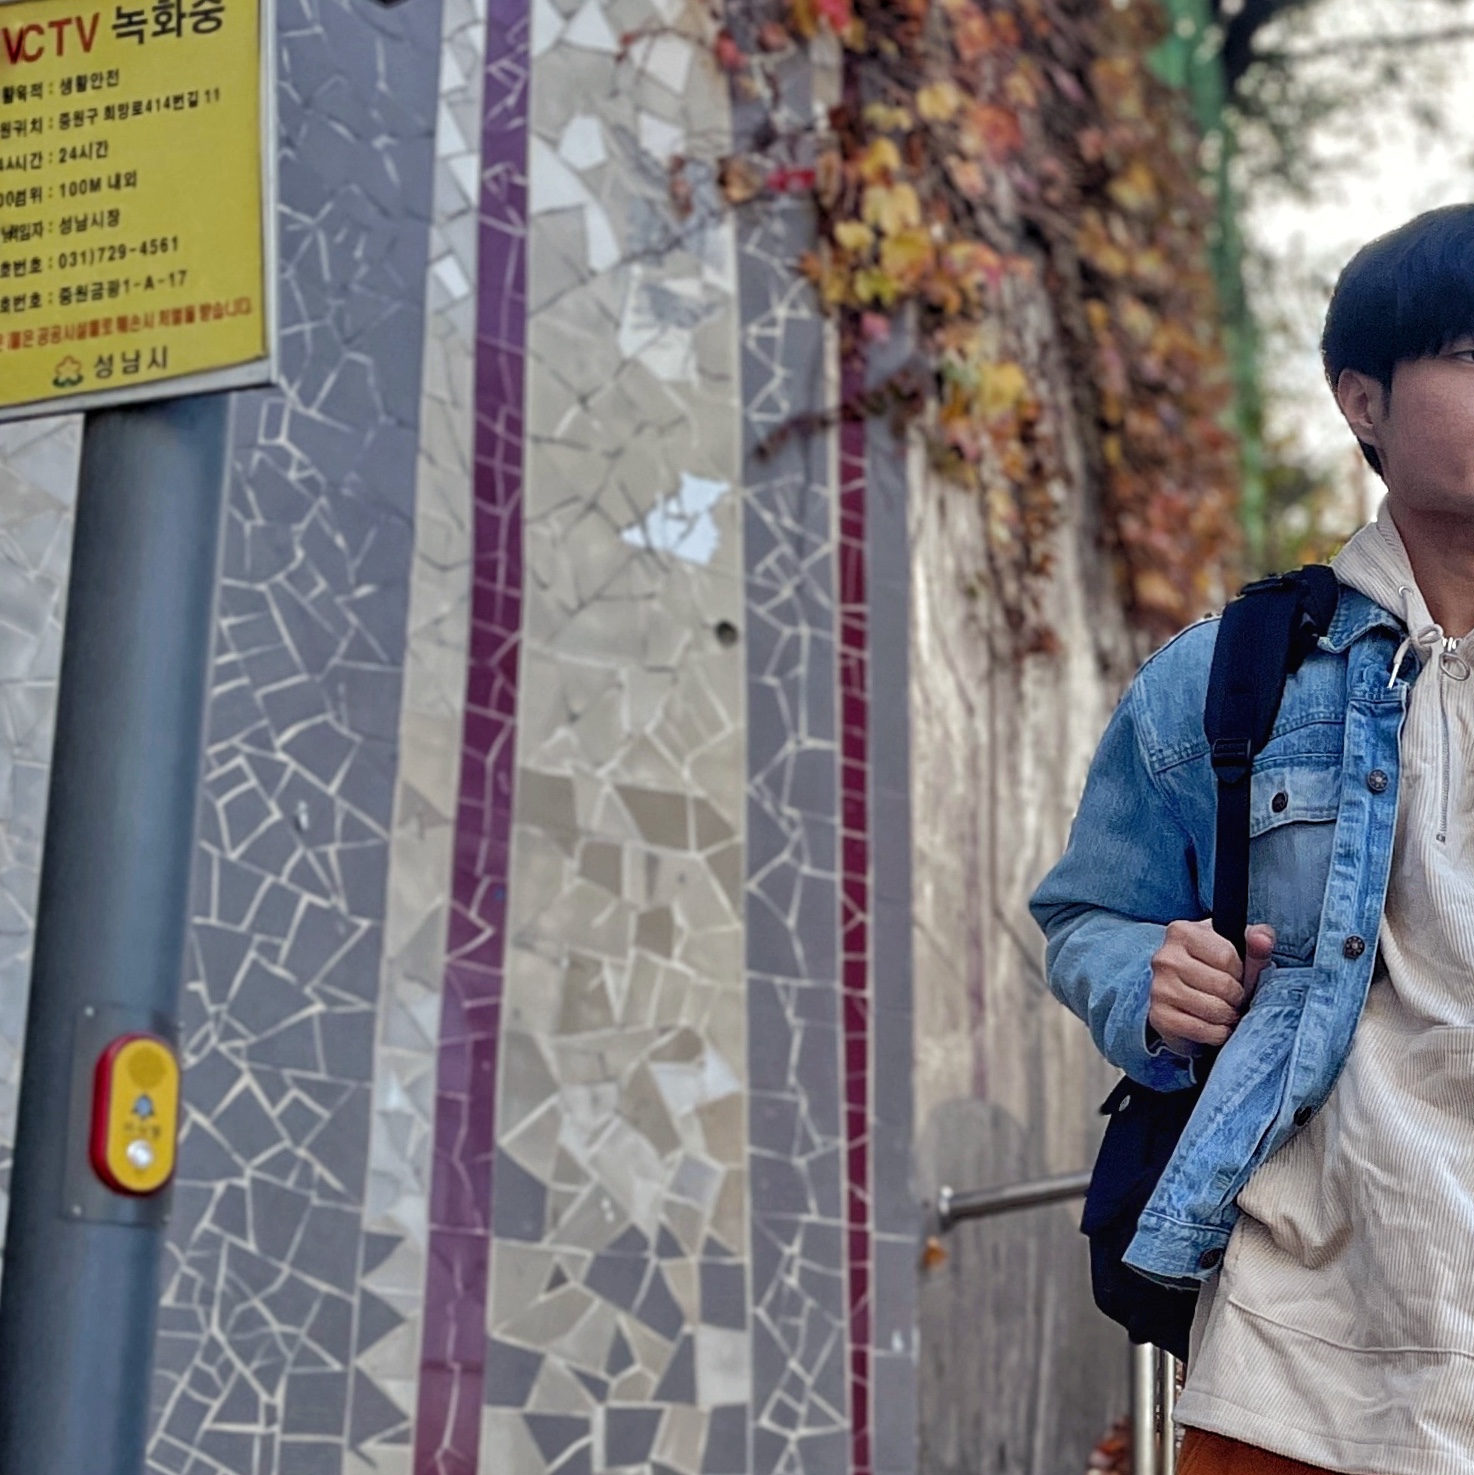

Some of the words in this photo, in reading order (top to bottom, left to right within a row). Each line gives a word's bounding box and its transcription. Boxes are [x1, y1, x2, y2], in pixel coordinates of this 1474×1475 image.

[111, 0, 225, 45] 녹화중
[58, 140, 109, 163] 24시간
[59, 177, 102, 198] 100M
[59, 208, 120, 236] 성남시장
[58, 236, 179, 270] 031)729-4561
[94, 346, 169, 379] 성남시
